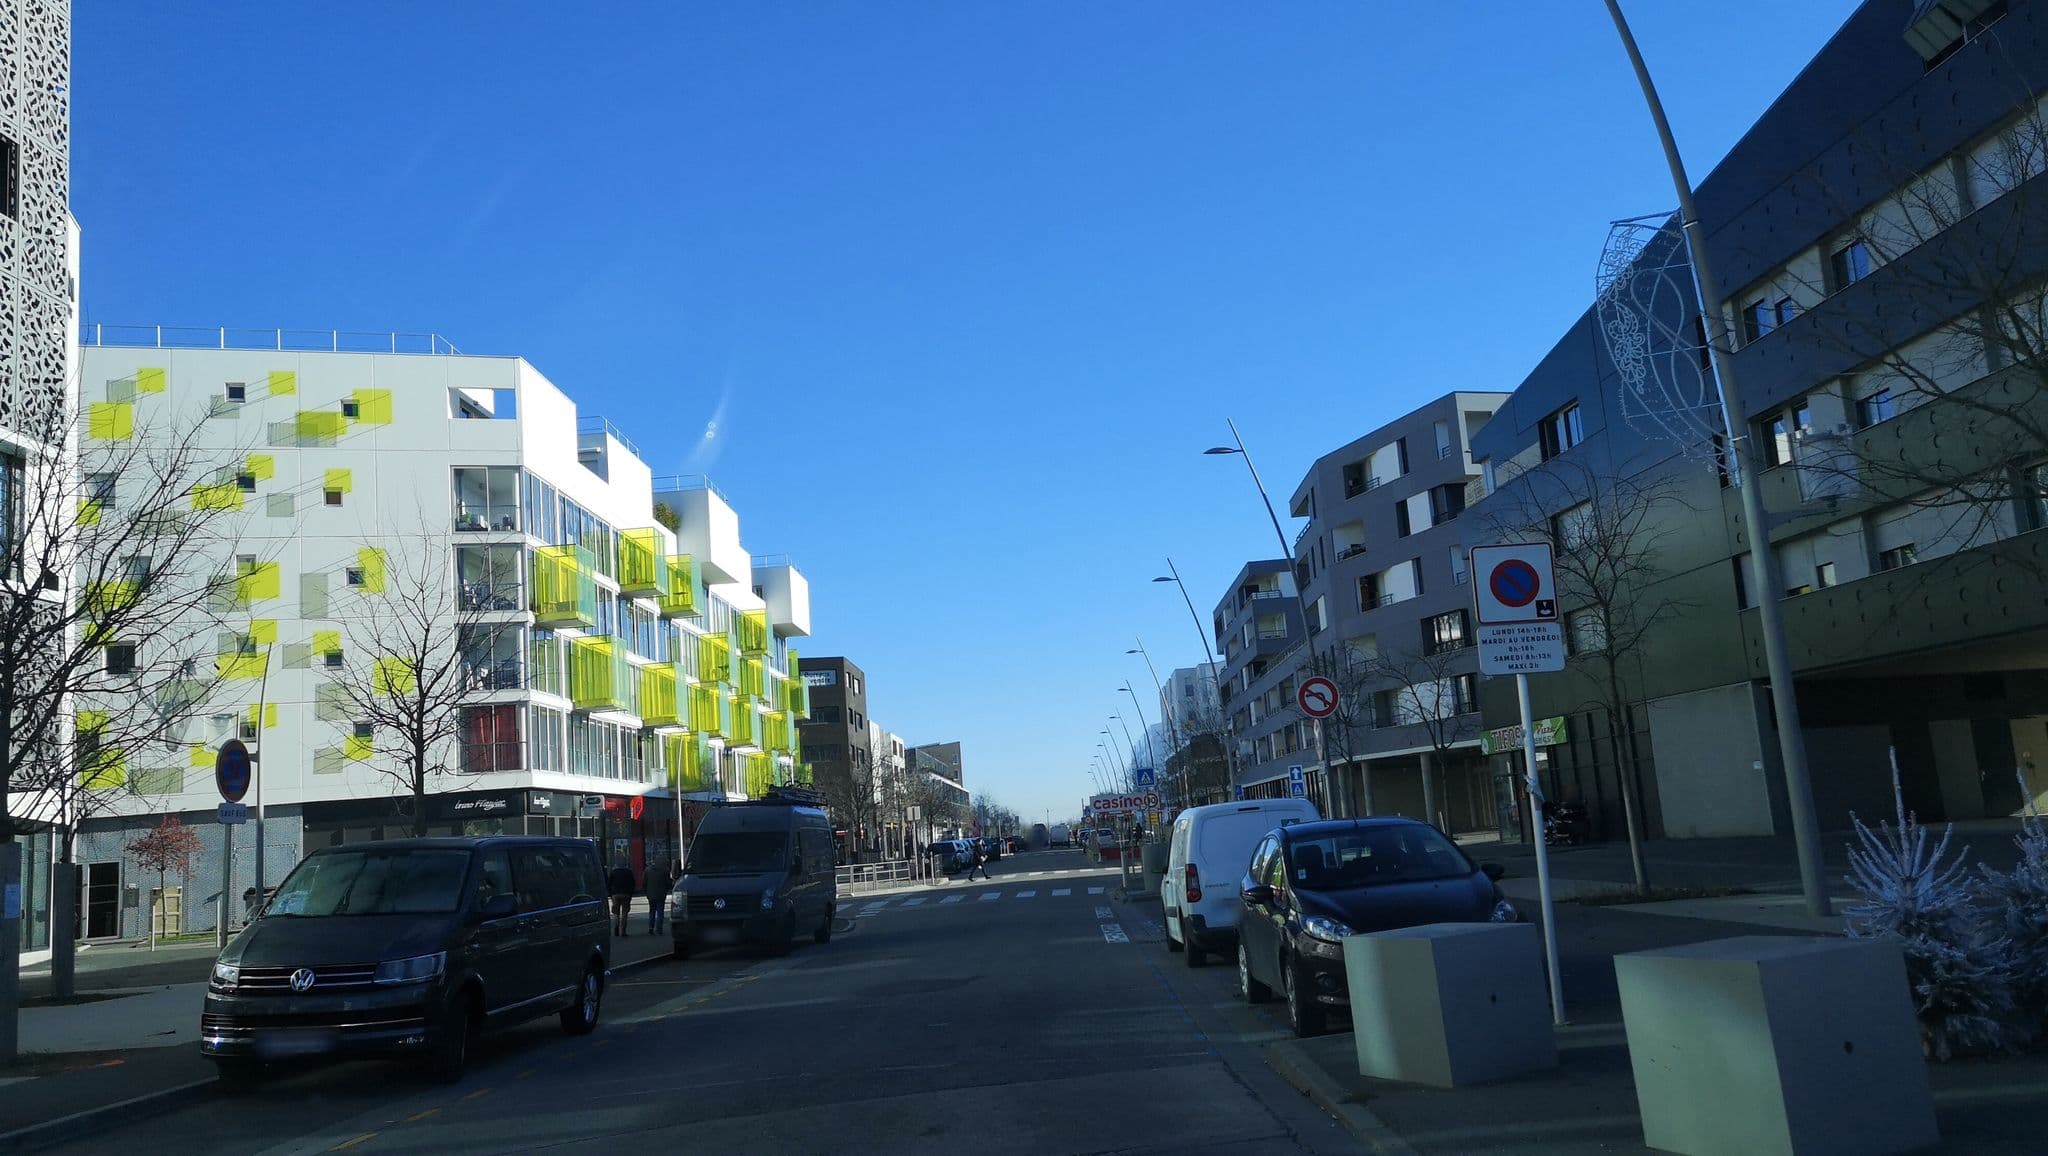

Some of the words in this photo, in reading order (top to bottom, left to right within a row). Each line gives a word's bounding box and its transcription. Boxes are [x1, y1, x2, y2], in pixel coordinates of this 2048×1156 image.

[1492, 628, 1515, 636] LUNDI
[1481, 637, 1506, 645] MARDI
[1508, 636, 1519, 644] AU
[1521, 634, 1560, 643] VENDREDI
[1494, 654, 1523, 662] SAMEDI
[1508, 662, 1527, 670] MAXI
[1491, 727, 1523, 750] TIFOS
[1093, 796, 1143, 810] casino
